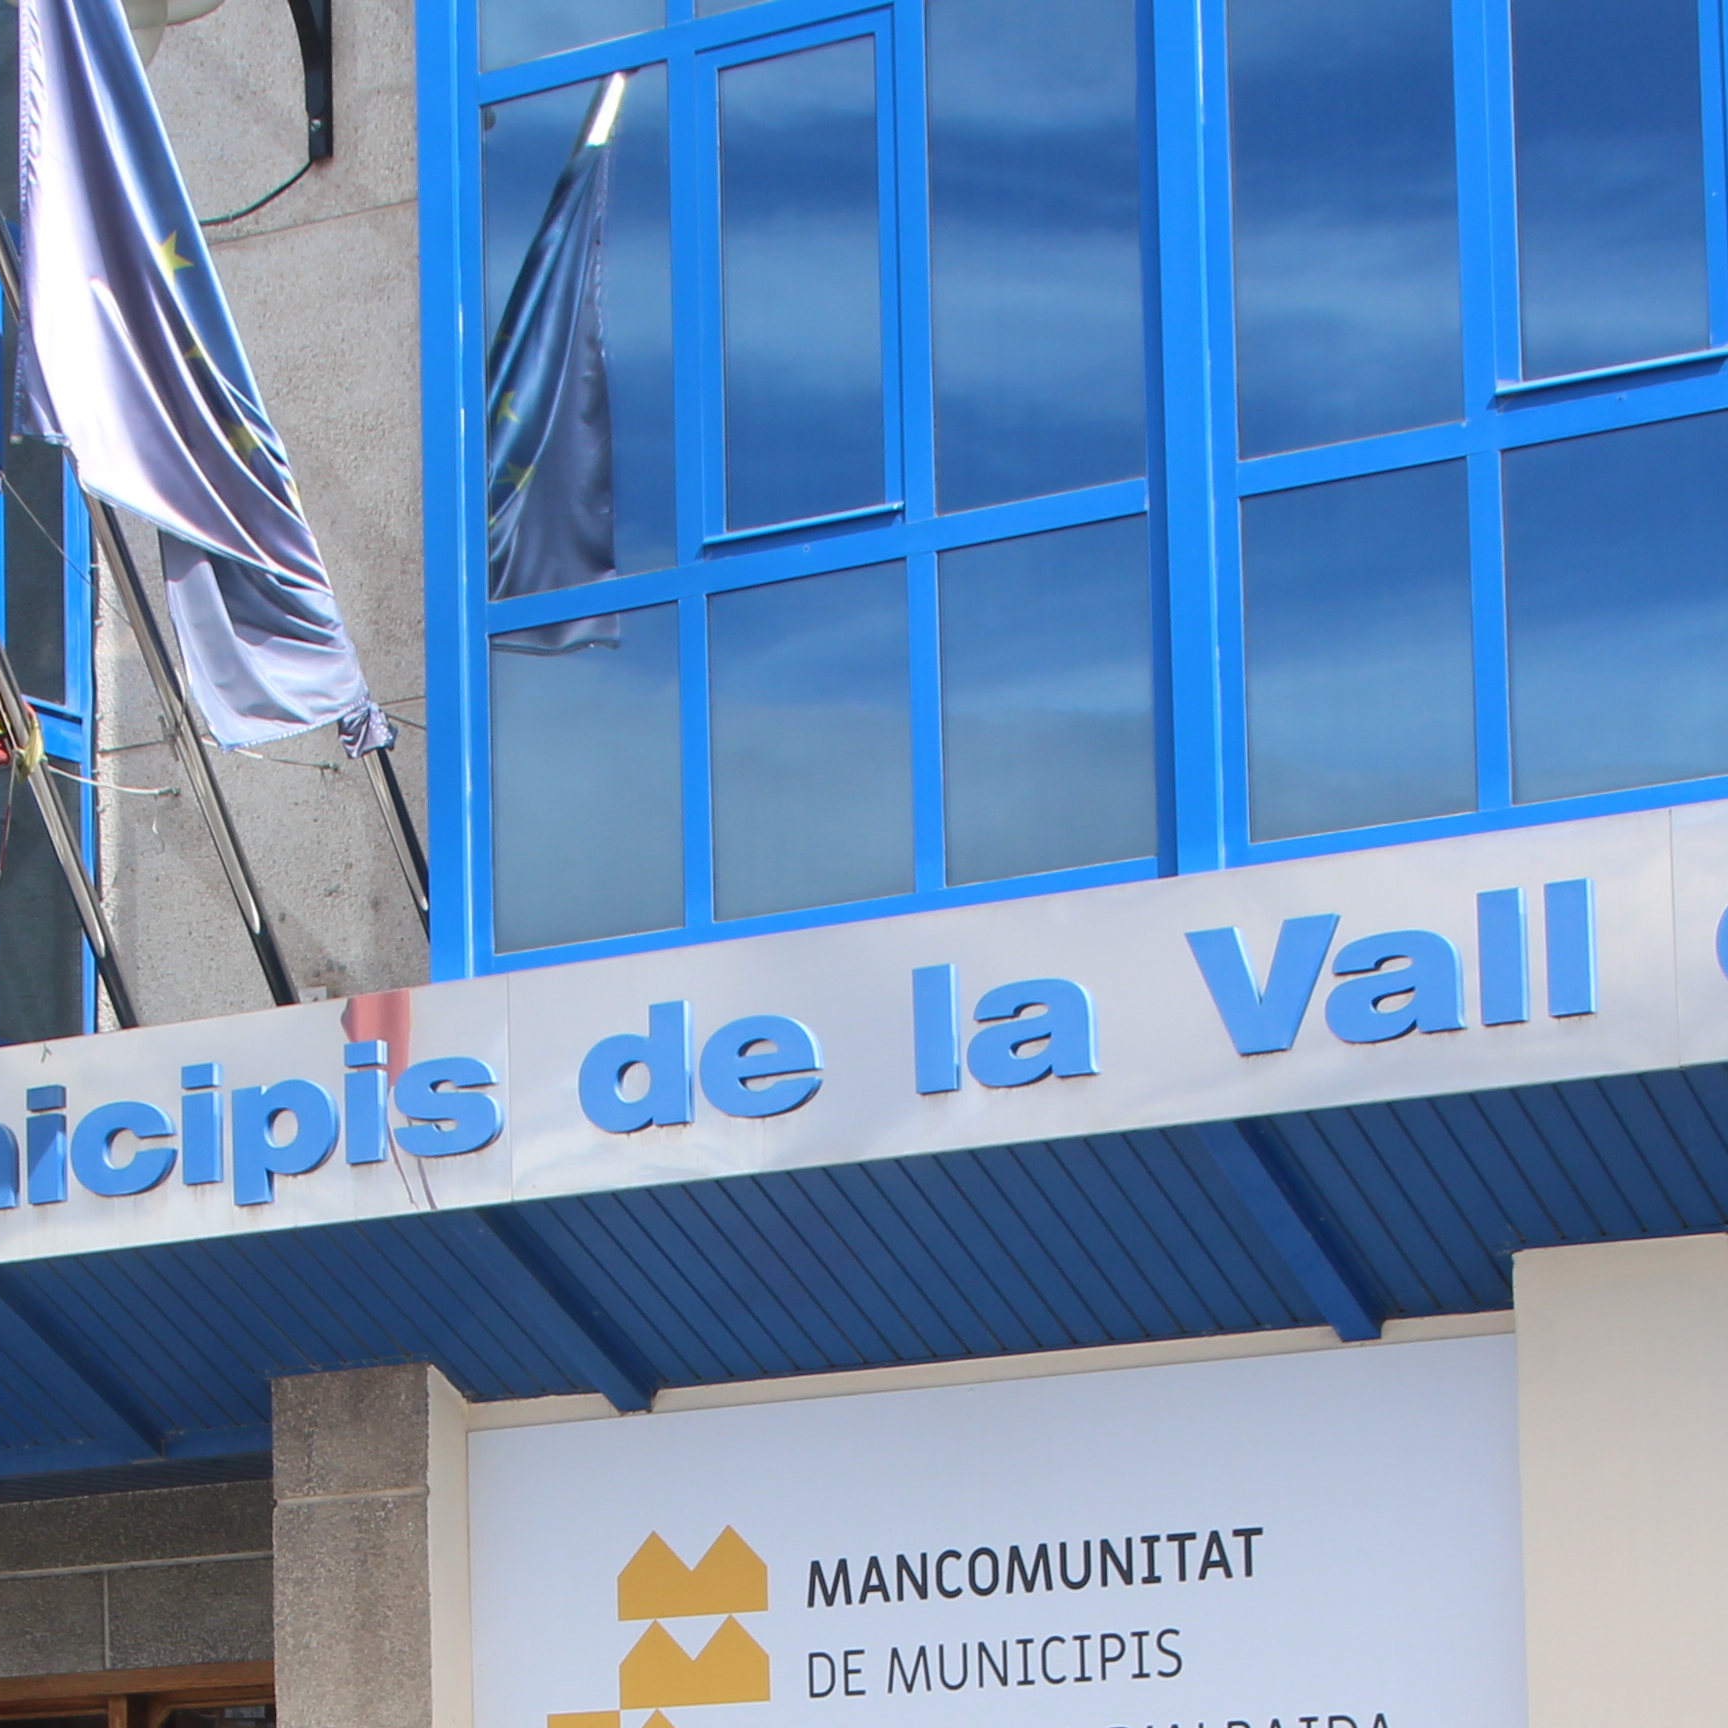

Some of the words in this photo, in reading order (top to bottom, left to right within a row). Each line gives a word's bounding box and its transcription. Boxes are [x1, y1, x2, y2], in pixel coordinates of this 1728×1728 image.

[578, 1000, 825, 1134] de
[911, 962, 1101, 1097] la
[1184, 877, 1599, 1058] Vall
[806, 1526, 1264, 1609] MANCOMUNITAT
[806, 1650, 866, 1699] DE
[886, 1628, 1184, 1696] MUNICIPIS
